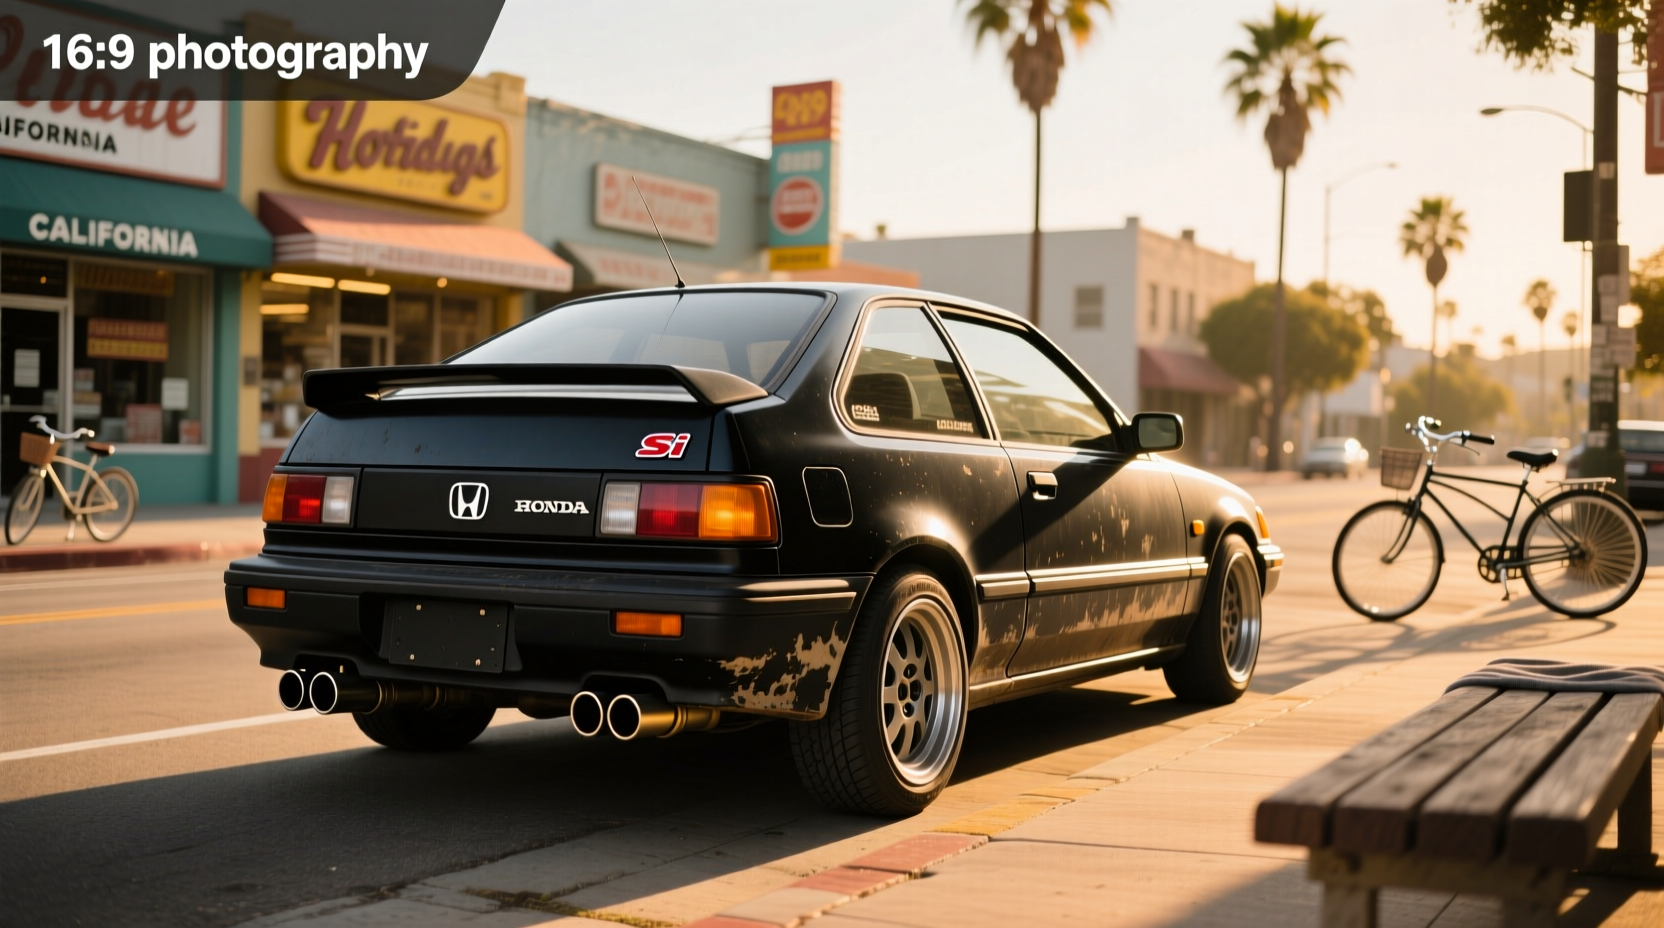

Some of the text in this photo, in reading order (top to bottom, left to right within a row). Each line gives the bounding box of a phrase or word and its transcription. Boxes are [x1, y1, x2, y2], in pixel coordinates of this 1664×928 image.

[29, 213, 198, 258] CALIFORNIA
[635, 433, 691, 458] Si
[514, 500, 589, 514] HONDA
